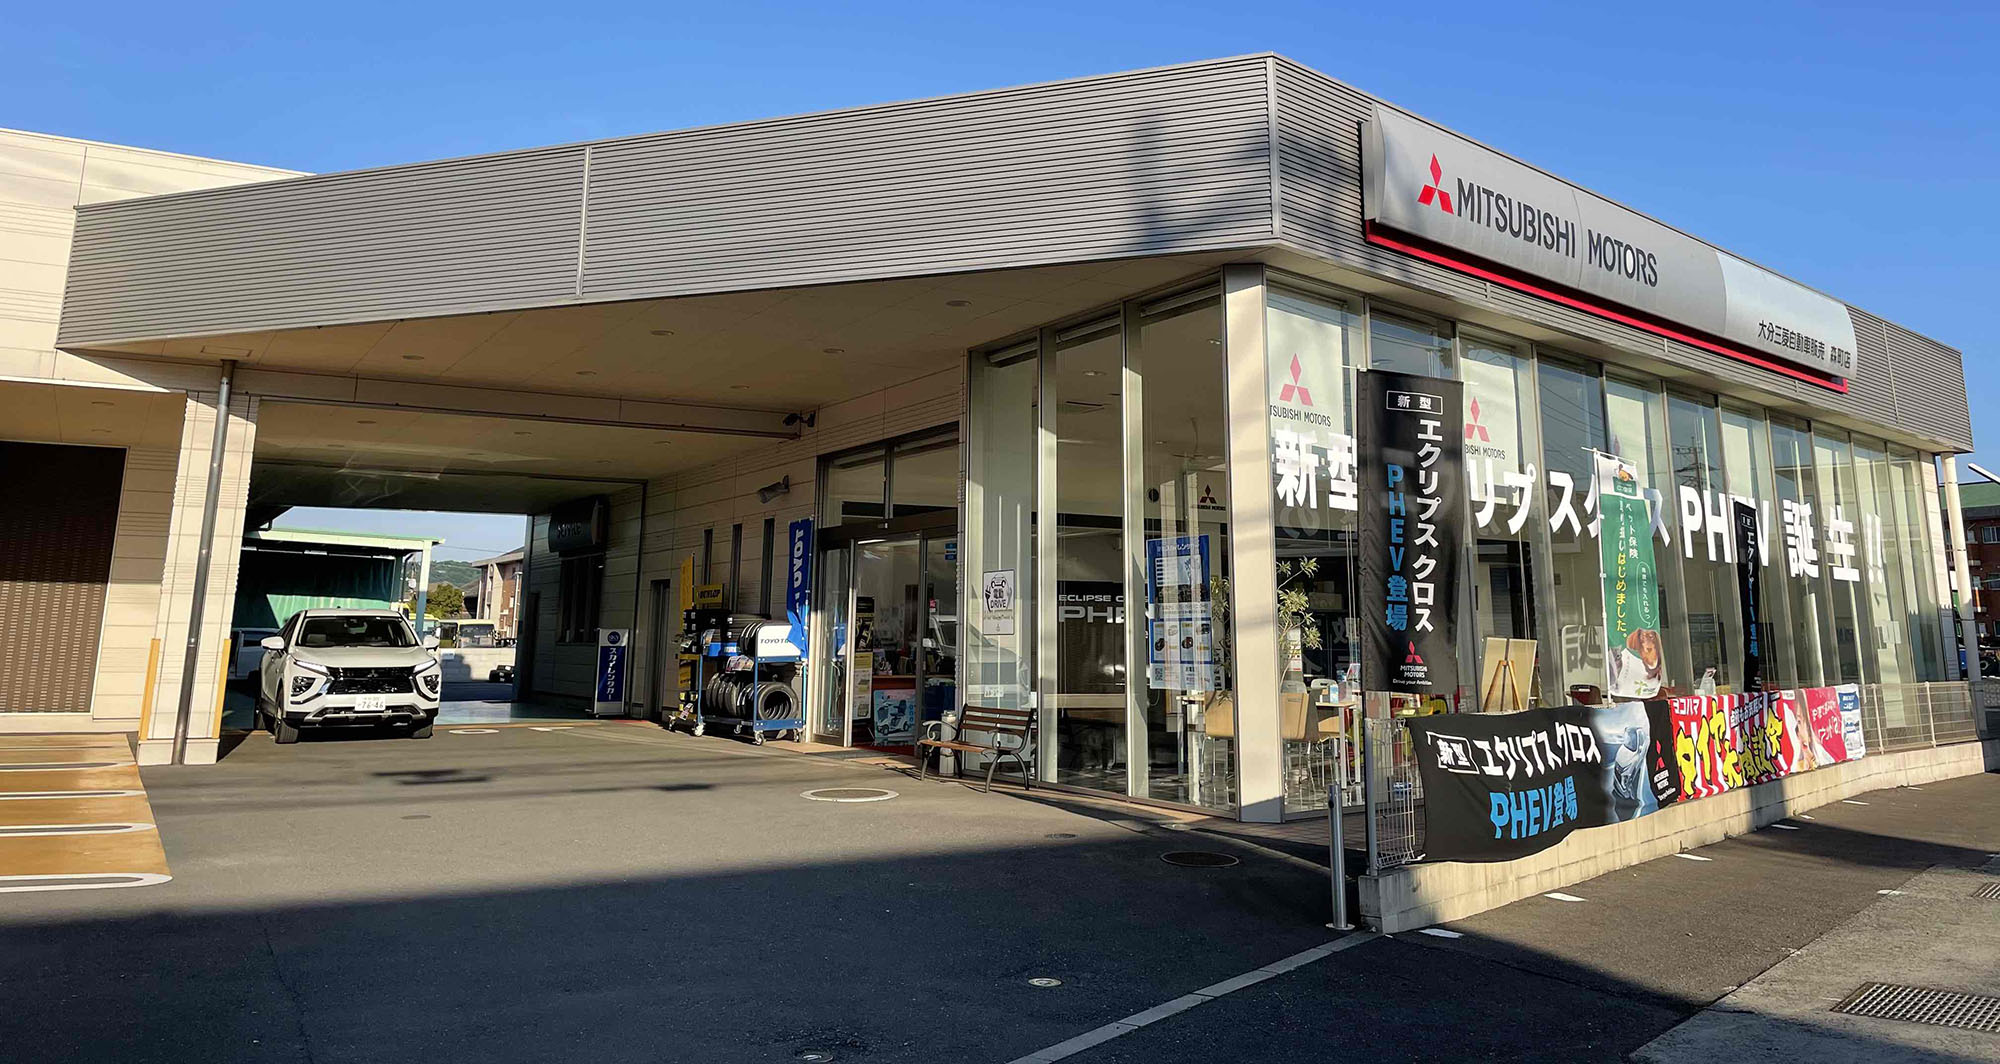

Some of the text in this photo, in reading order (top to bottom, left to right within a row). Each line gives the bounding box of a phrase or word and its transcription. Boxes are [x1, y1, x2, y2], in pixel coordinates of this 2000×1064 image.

[1457, 177, 1658, 288] MITSUBISHI MOTORS
[1758, 319, 1852, 369] 大分三菱自動車販売 森町店
[1304, 411, 1332, 428] MOTORS
[1397, 394, 1432, 411] 新型
[1385, 463, 1409, 632] PHEV登場
[1058, 594, 1111, 602] ECLIPSE
[606, 647, 617, 701] スカイレンタカー
[1672, 698, 1700, 716] ヨコハマ
[1436, 738, 1472, 767] 新型
[1489, 775, 1578, 840] PHEV登場
